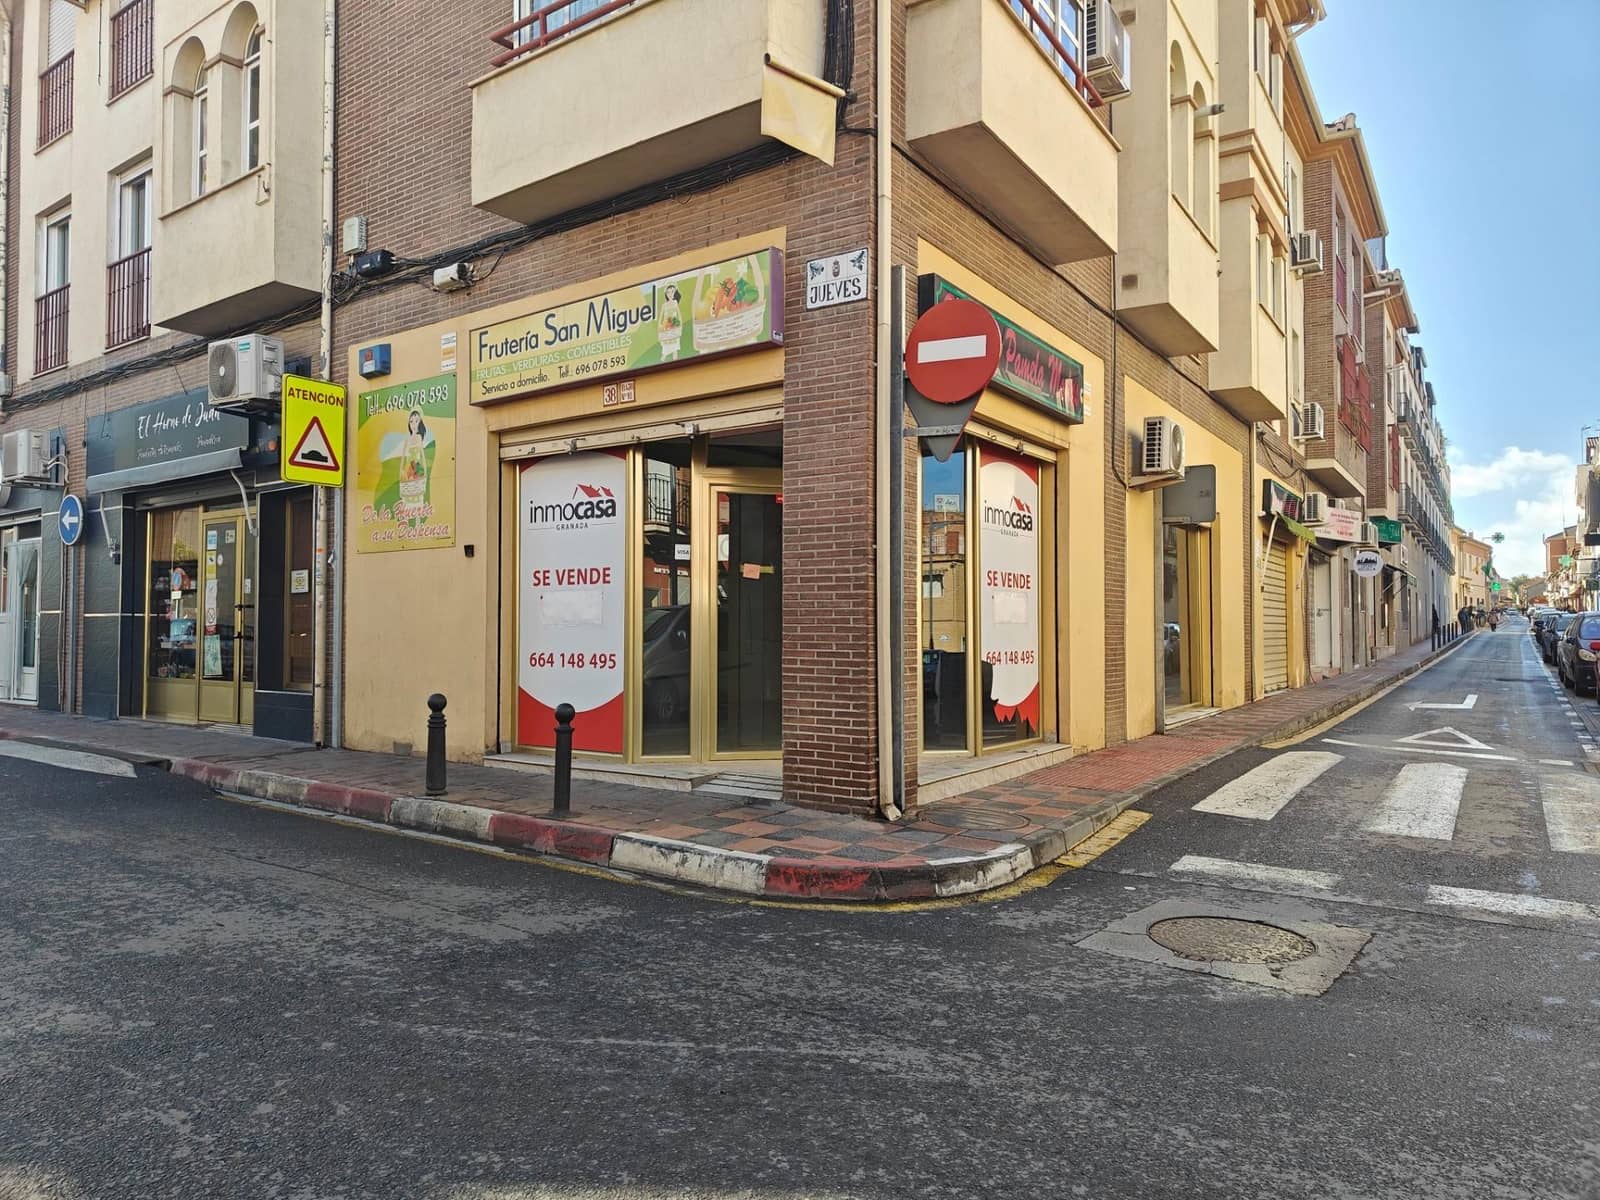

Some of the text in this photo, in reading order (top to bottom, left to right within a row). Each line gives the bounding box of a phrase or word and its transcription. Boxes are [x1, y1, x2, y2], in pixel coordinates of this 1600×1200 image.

[810, 278, 861, 304] JUEVES
[479, 330, 539, 363] Frutería
[544, 313, 580, 346] San
[586, 285, 657, 337] Miguel
[476, 366, 506, 380] FRUTAS
[512, 352, 561, 371] VERDURAS
[566, 336, 632, 359] COMESTIBLES
[481, 381, 509, 395] Servicio
[510, 381, 515, 389] a
[575, 363, 590, 375] 696
[592, 359, 608, 372] 078
[610, 355, 626, 368] 593
[385, 395, 405, 412] 696
[406, 389, 426, 408] 078
[428, 384, 448, 403] 593
[137, 402, 221, 439] El Horno de Juan
[362, 500, 433, 522] De la Huerta
[530, 498, 616, 523] inmocasa
[984, 499, 1033, 531] inmocasa
[382, 530, 394, 540] su
[397, 521, 449, 541] Despensa
[556, 522, 588, 531] GRANADA
[532, 567, 611, 587] SE VENDE
[986, 570, 1031, 589] SE VENDE
[529, 652, 617, 669] 664 148 495
[986, 650, 1034, 666] 664 148 495
